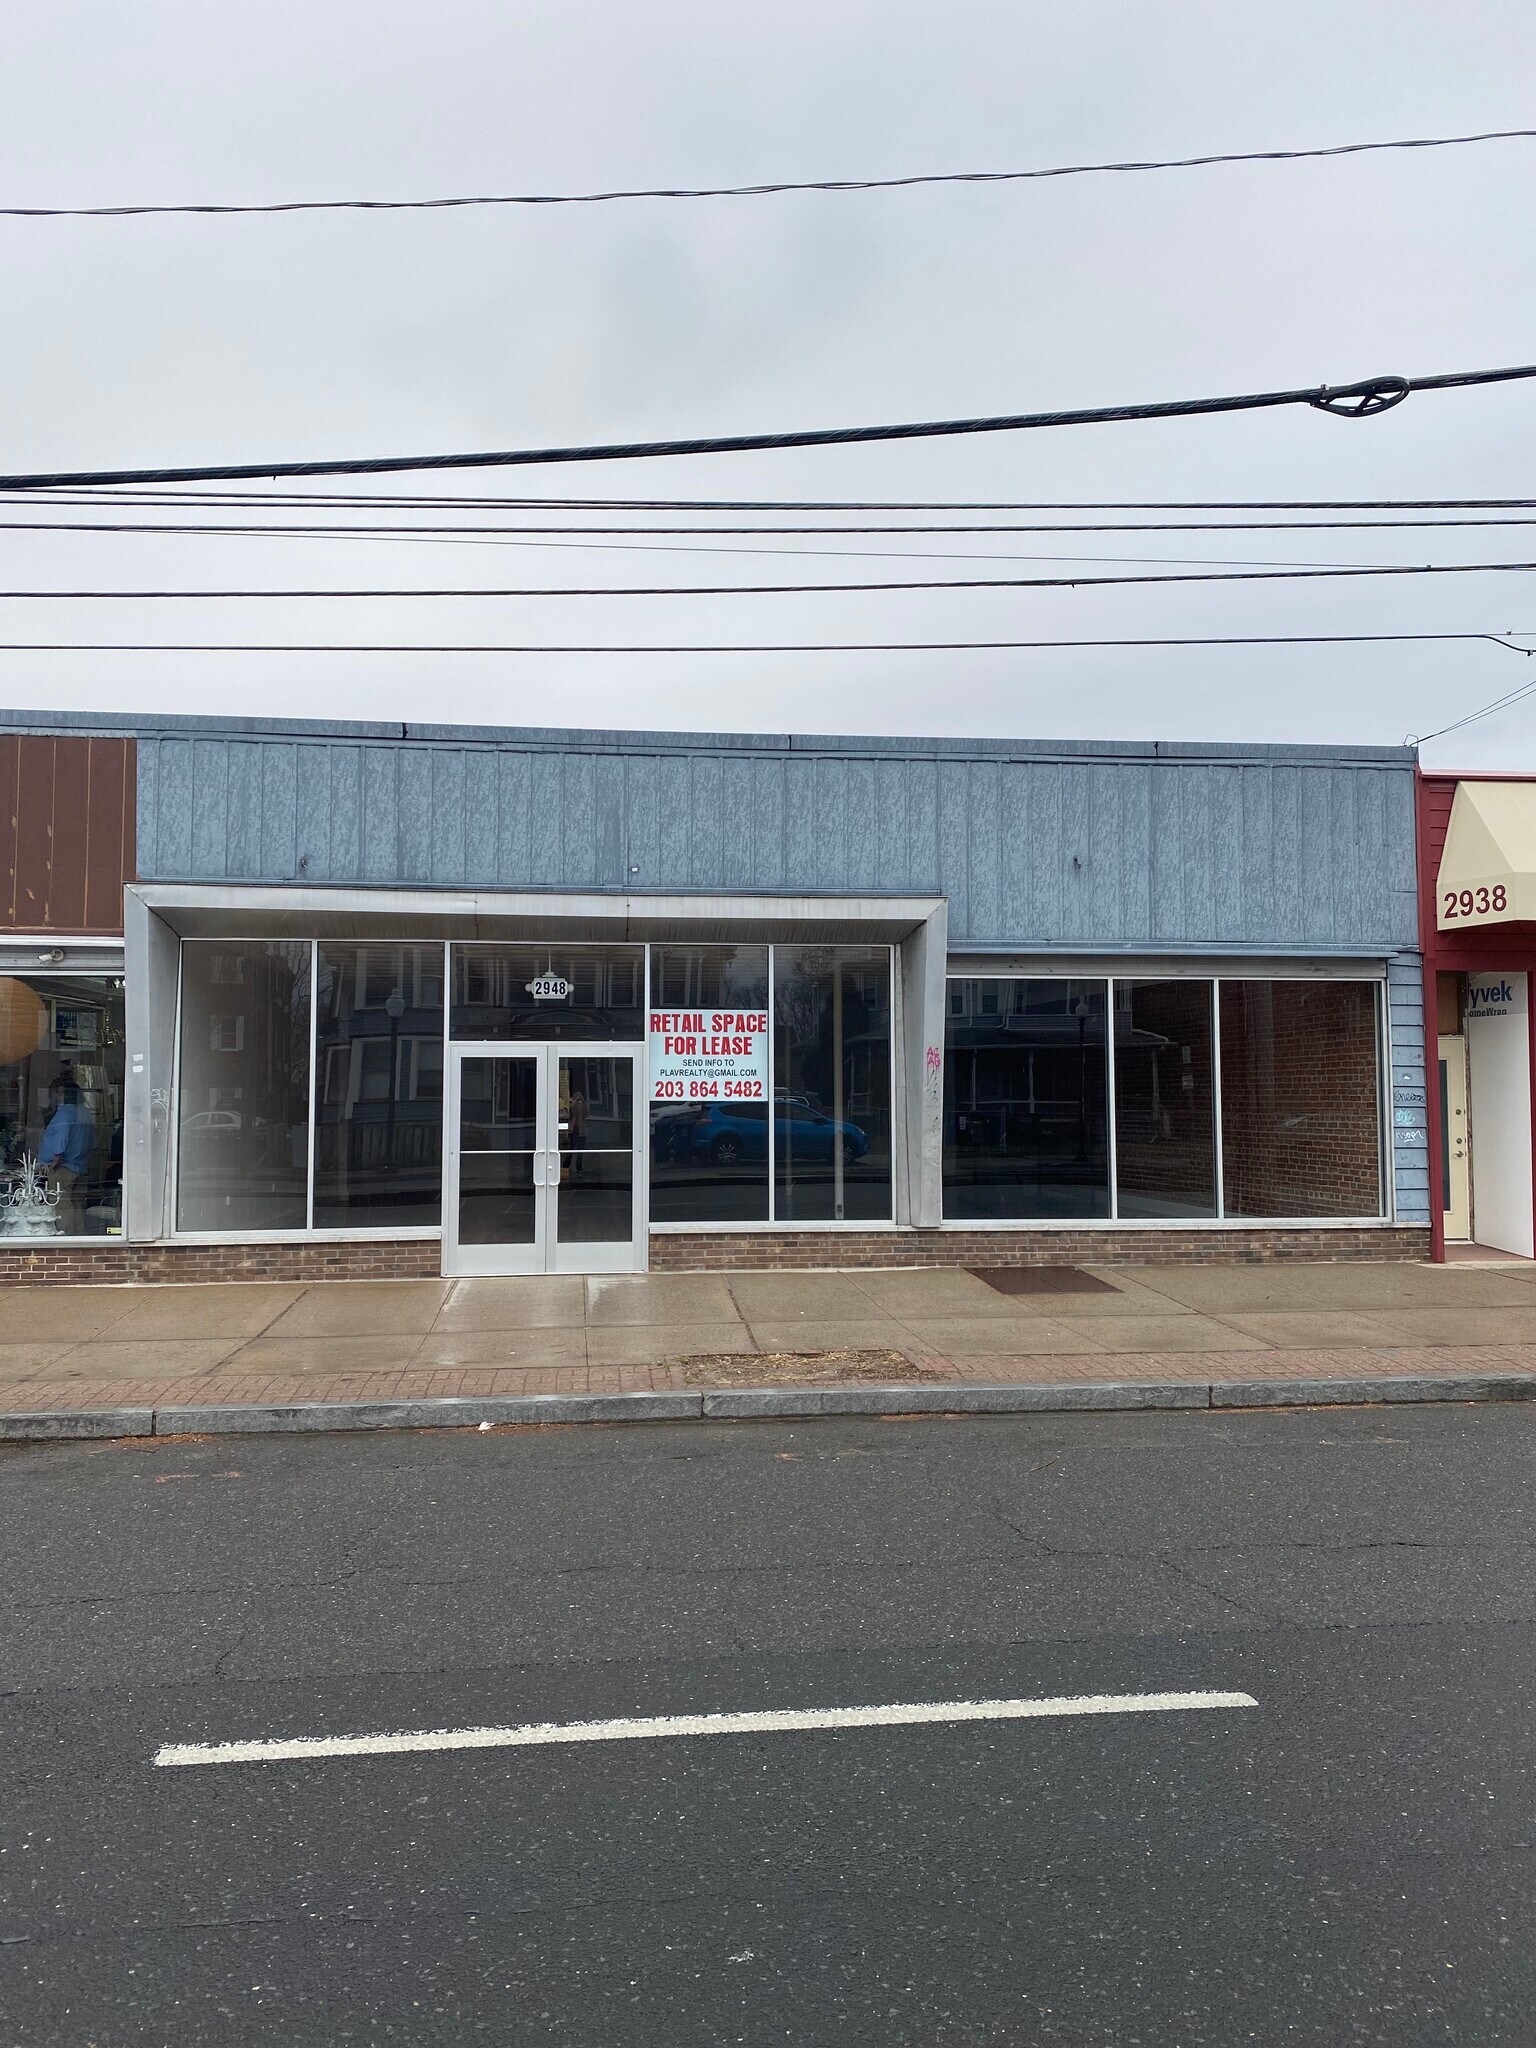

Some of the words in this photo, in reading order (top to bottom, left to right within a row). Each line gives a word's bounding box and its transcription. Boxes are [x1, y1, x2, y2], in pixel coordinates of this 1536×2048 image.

[1444, 884, 1507, 919] 2938
[535, 981, 566, 995] 2948
[1469, 980, 1513, 1009] yvek
[1469, 1007, 1507, 1018] omeWrap
[650, 1013, 707, 1033] RETAIL
[711, 1013, 767, 1033] SPACE
[664, 1036, 697, 1055] FOR
[701, 1036, 753, 1055] LEASE
[682, 1059, 704, 1067] SEND
[704, 1059, 723, 1067] INFO
[724, 1059, 735, 1067] TO
[660, 1069, 757, 1078] PLAVREALTY@GMAIL.COM
[655, 1081, 684, 1098] 203
[689, 1081, 719, 1098] 864
[723, 1081, 763, 1098] 5482
